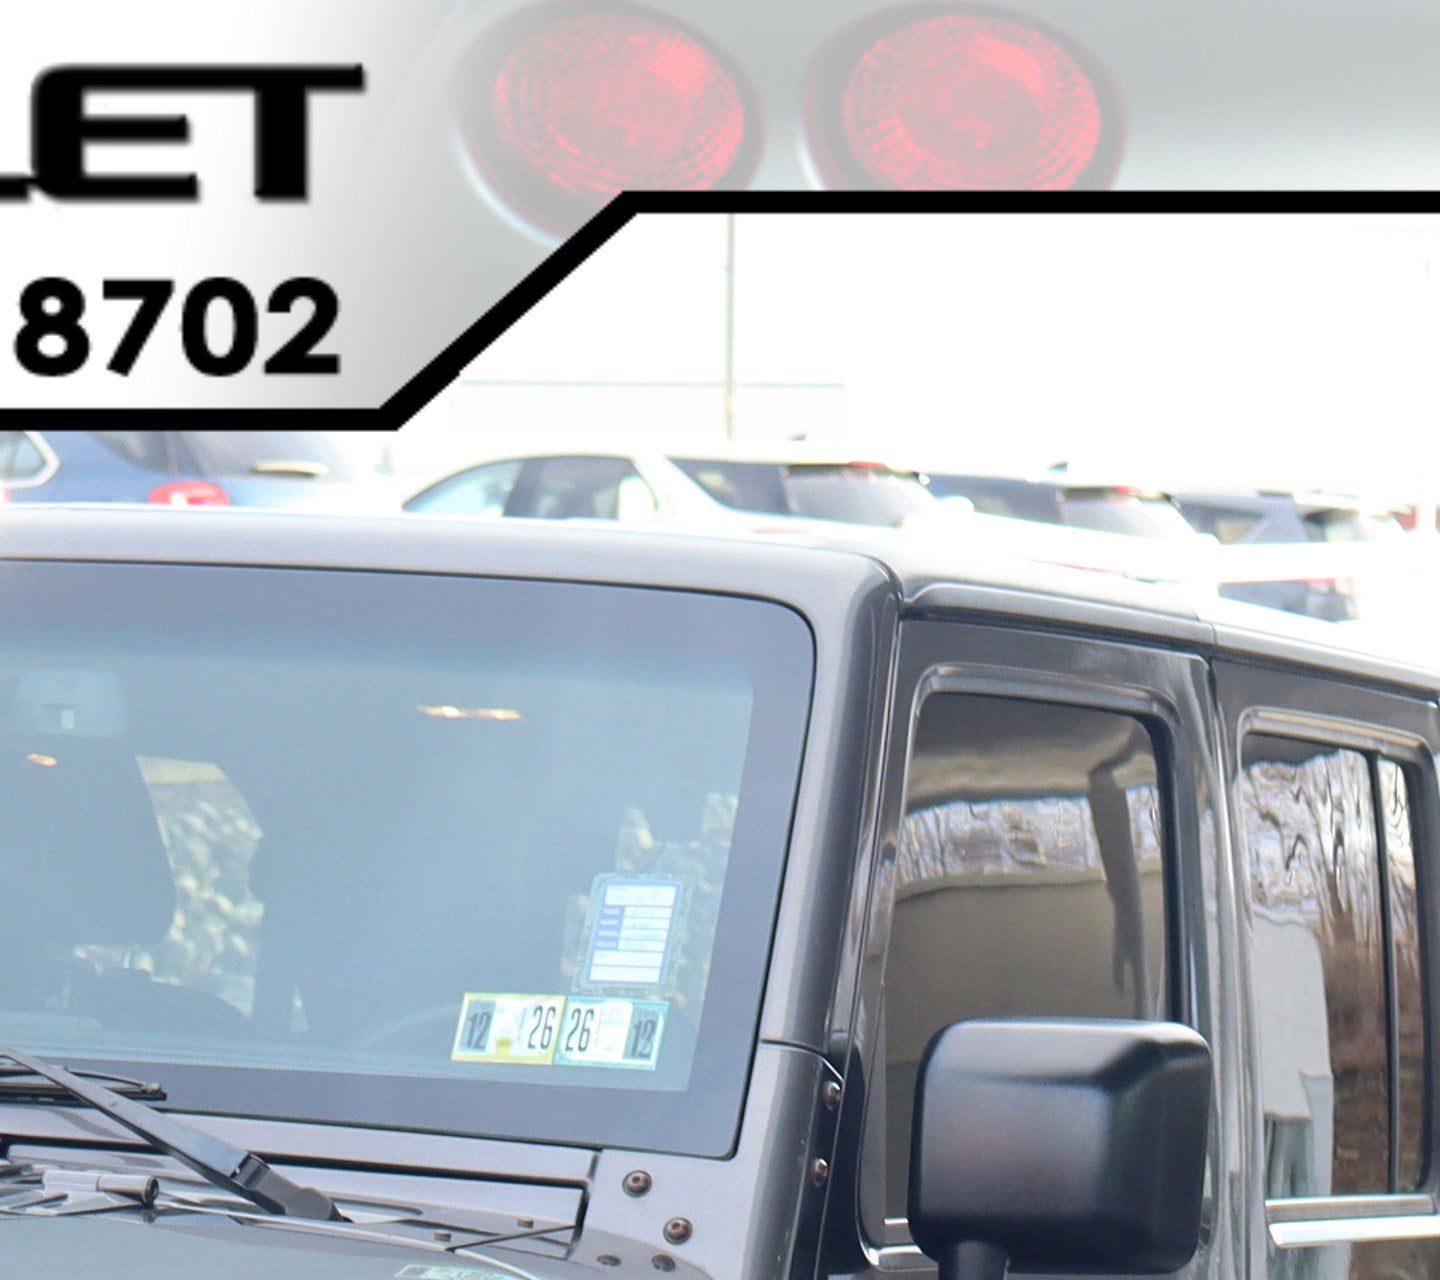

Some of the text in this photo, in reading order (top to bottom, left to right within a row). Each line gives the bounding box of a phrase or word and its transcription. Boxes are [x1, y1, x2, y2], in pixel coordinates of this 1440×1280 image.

[467, 1004, 557, 1052] 12 26
[565, 1007, 595, 1053] 26
